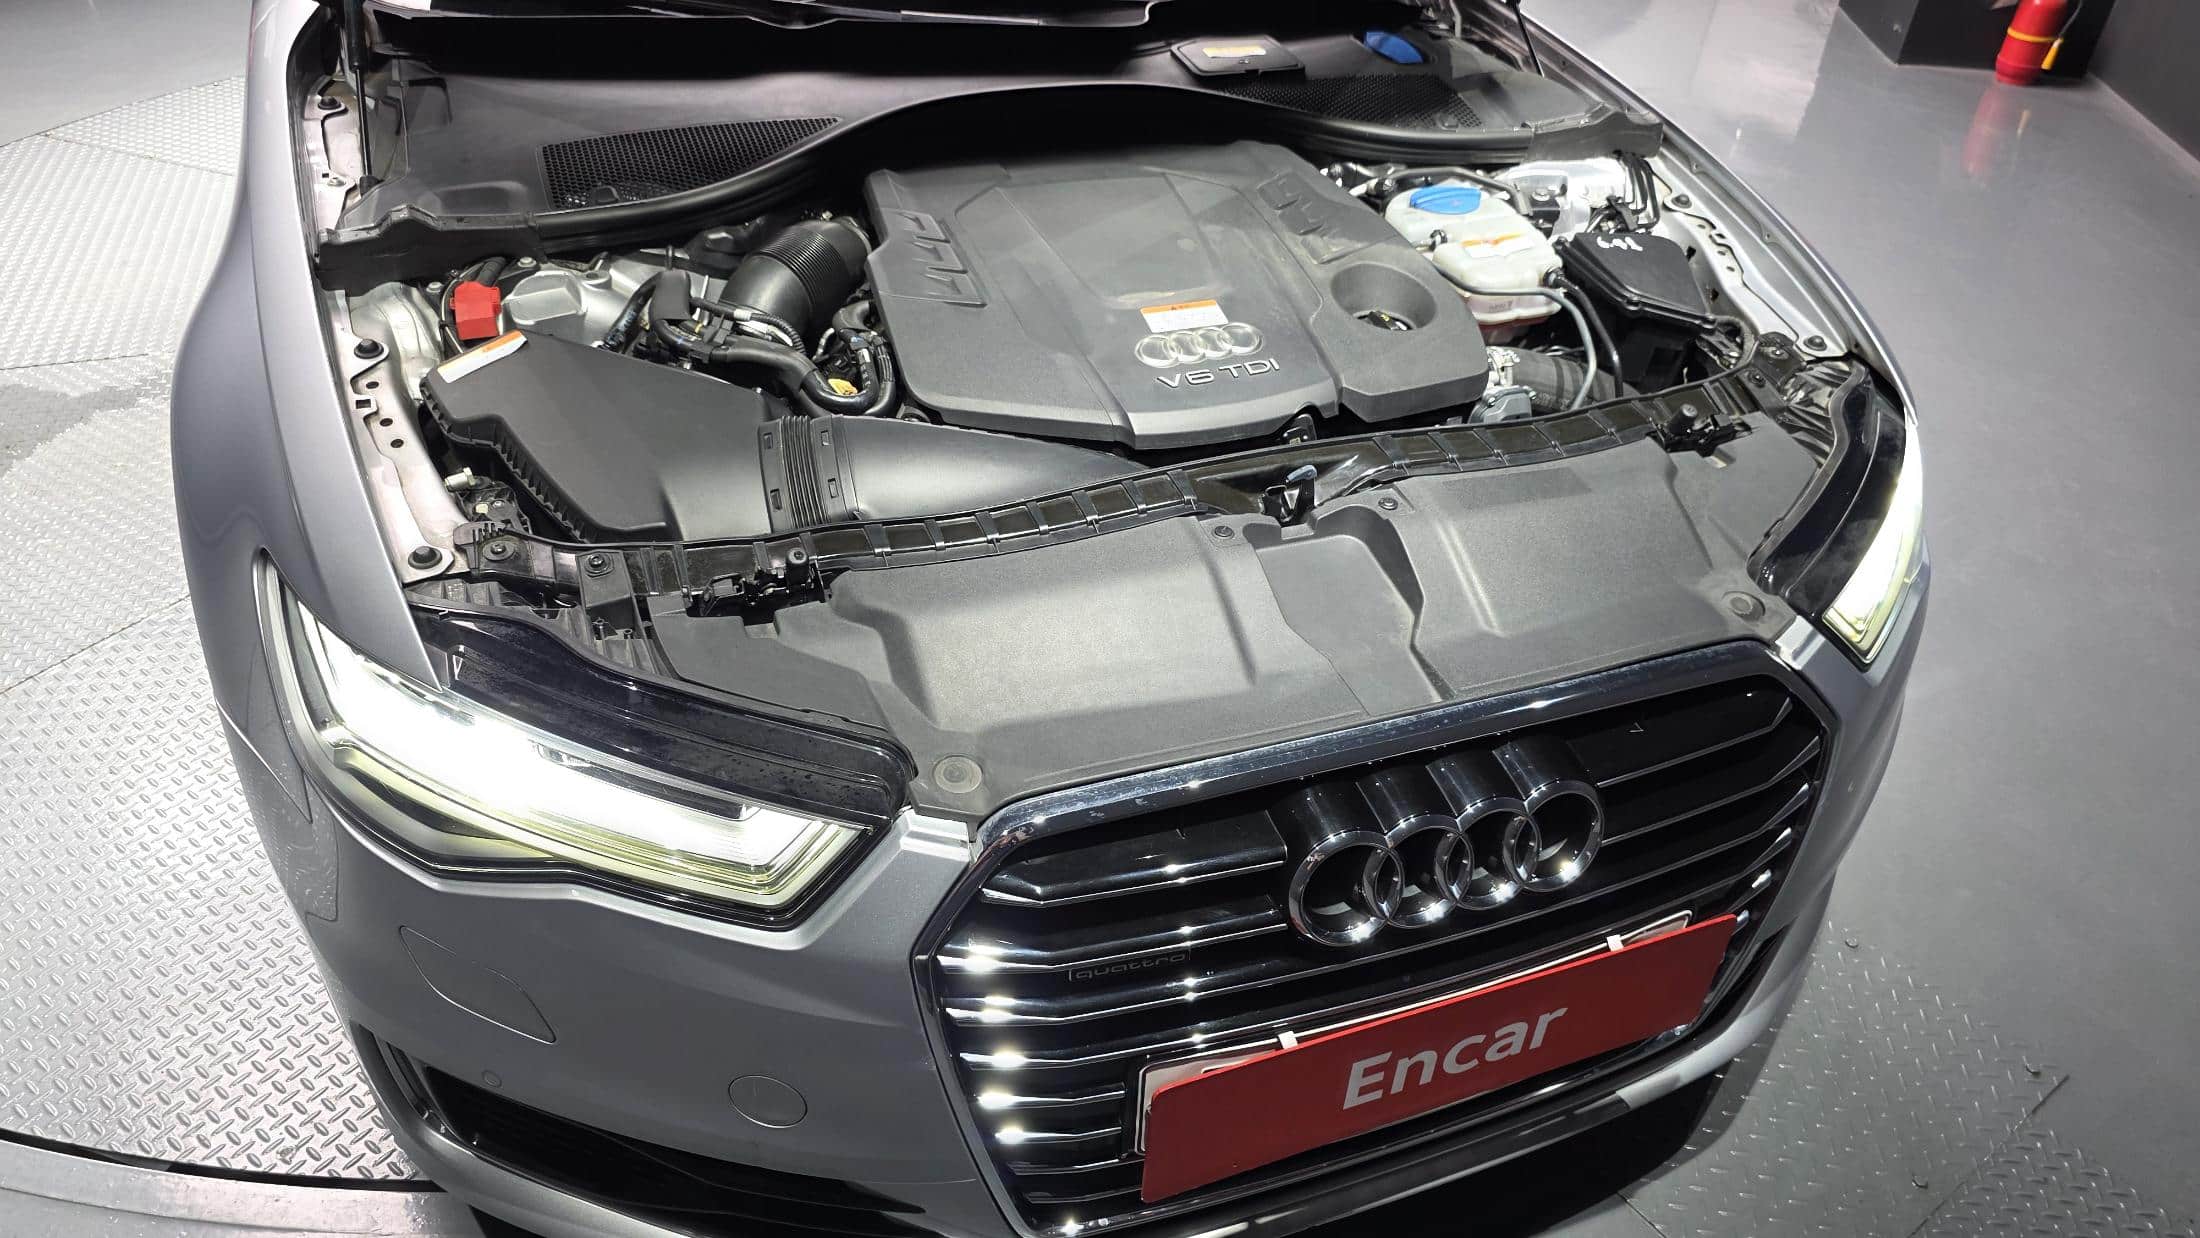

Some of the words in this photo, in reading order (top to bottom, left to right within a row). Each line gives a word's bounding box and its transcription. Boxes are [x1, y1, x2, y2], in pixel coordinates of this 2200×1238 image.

[1156, 368, 1215, 388] V6
[1218, 357, 1281, 378] TDI
[1075, 953, 1186, 979] quattro
[1342, 1007, 1568, 1110] Encar
